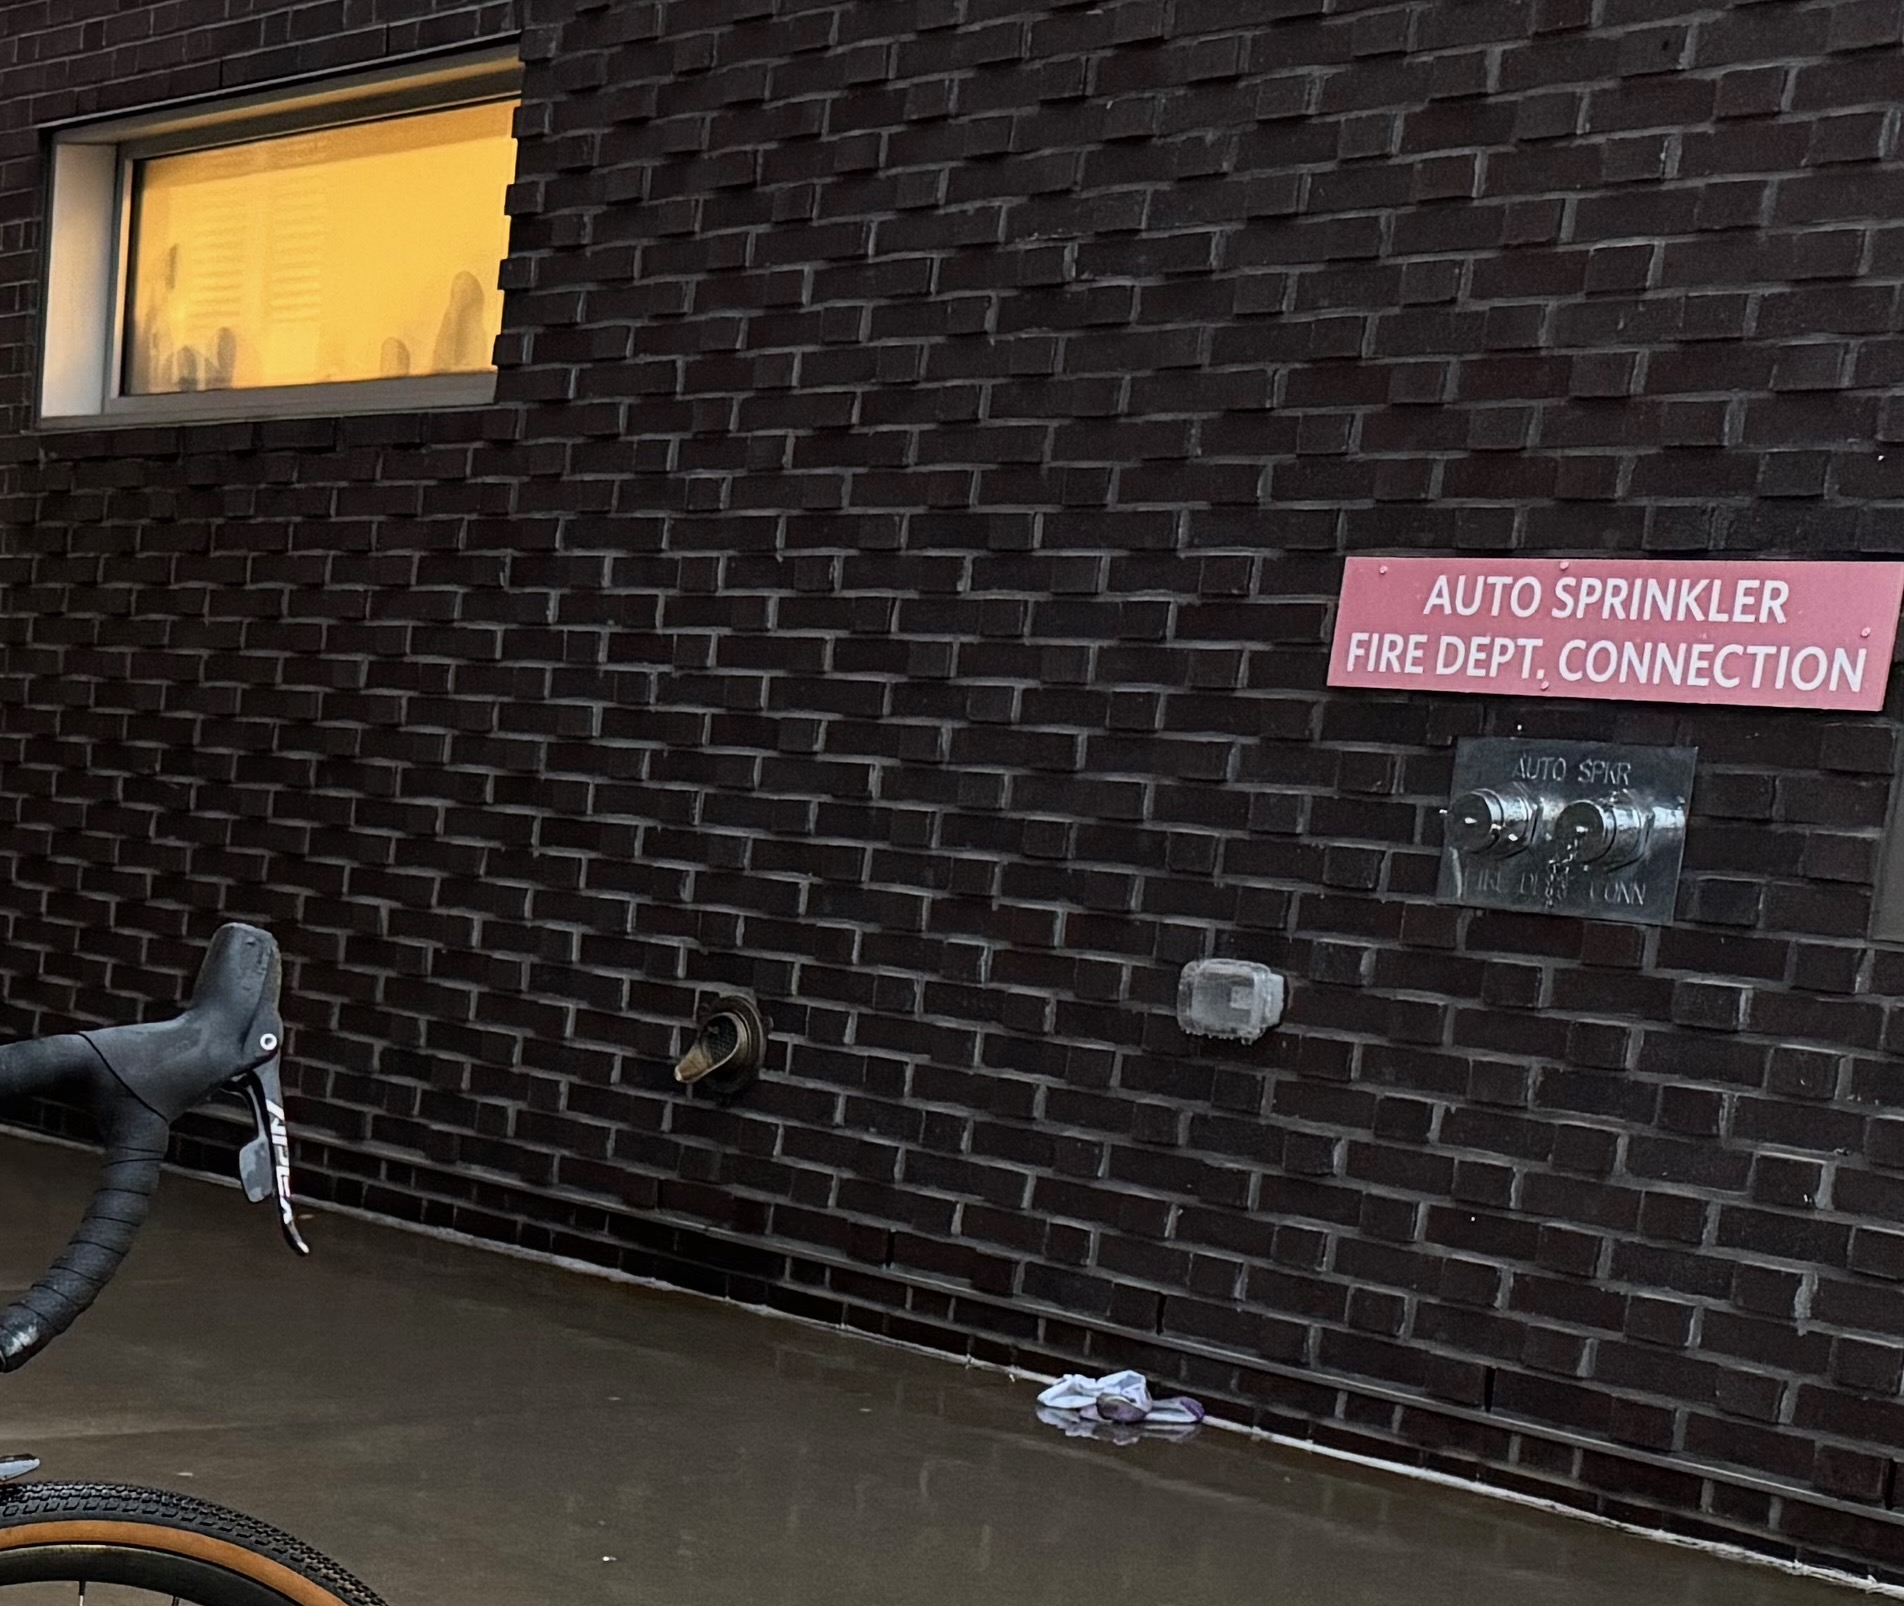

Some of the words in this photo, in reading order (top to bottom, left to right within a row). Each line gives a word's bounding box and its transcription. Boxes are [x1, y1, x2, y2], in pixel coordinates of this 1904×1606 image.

[1424, 575, 1542, 617] AUTO
[1552, 577, 1789, 624] SPRINKLER
[1347, 632, 1427, 674] FIRE
[1436, 635, 1545, 680] DEPT.
[1559, 639, 1867, 692] CONNECTION
[1512, 754, 1566, 782] AUTO
